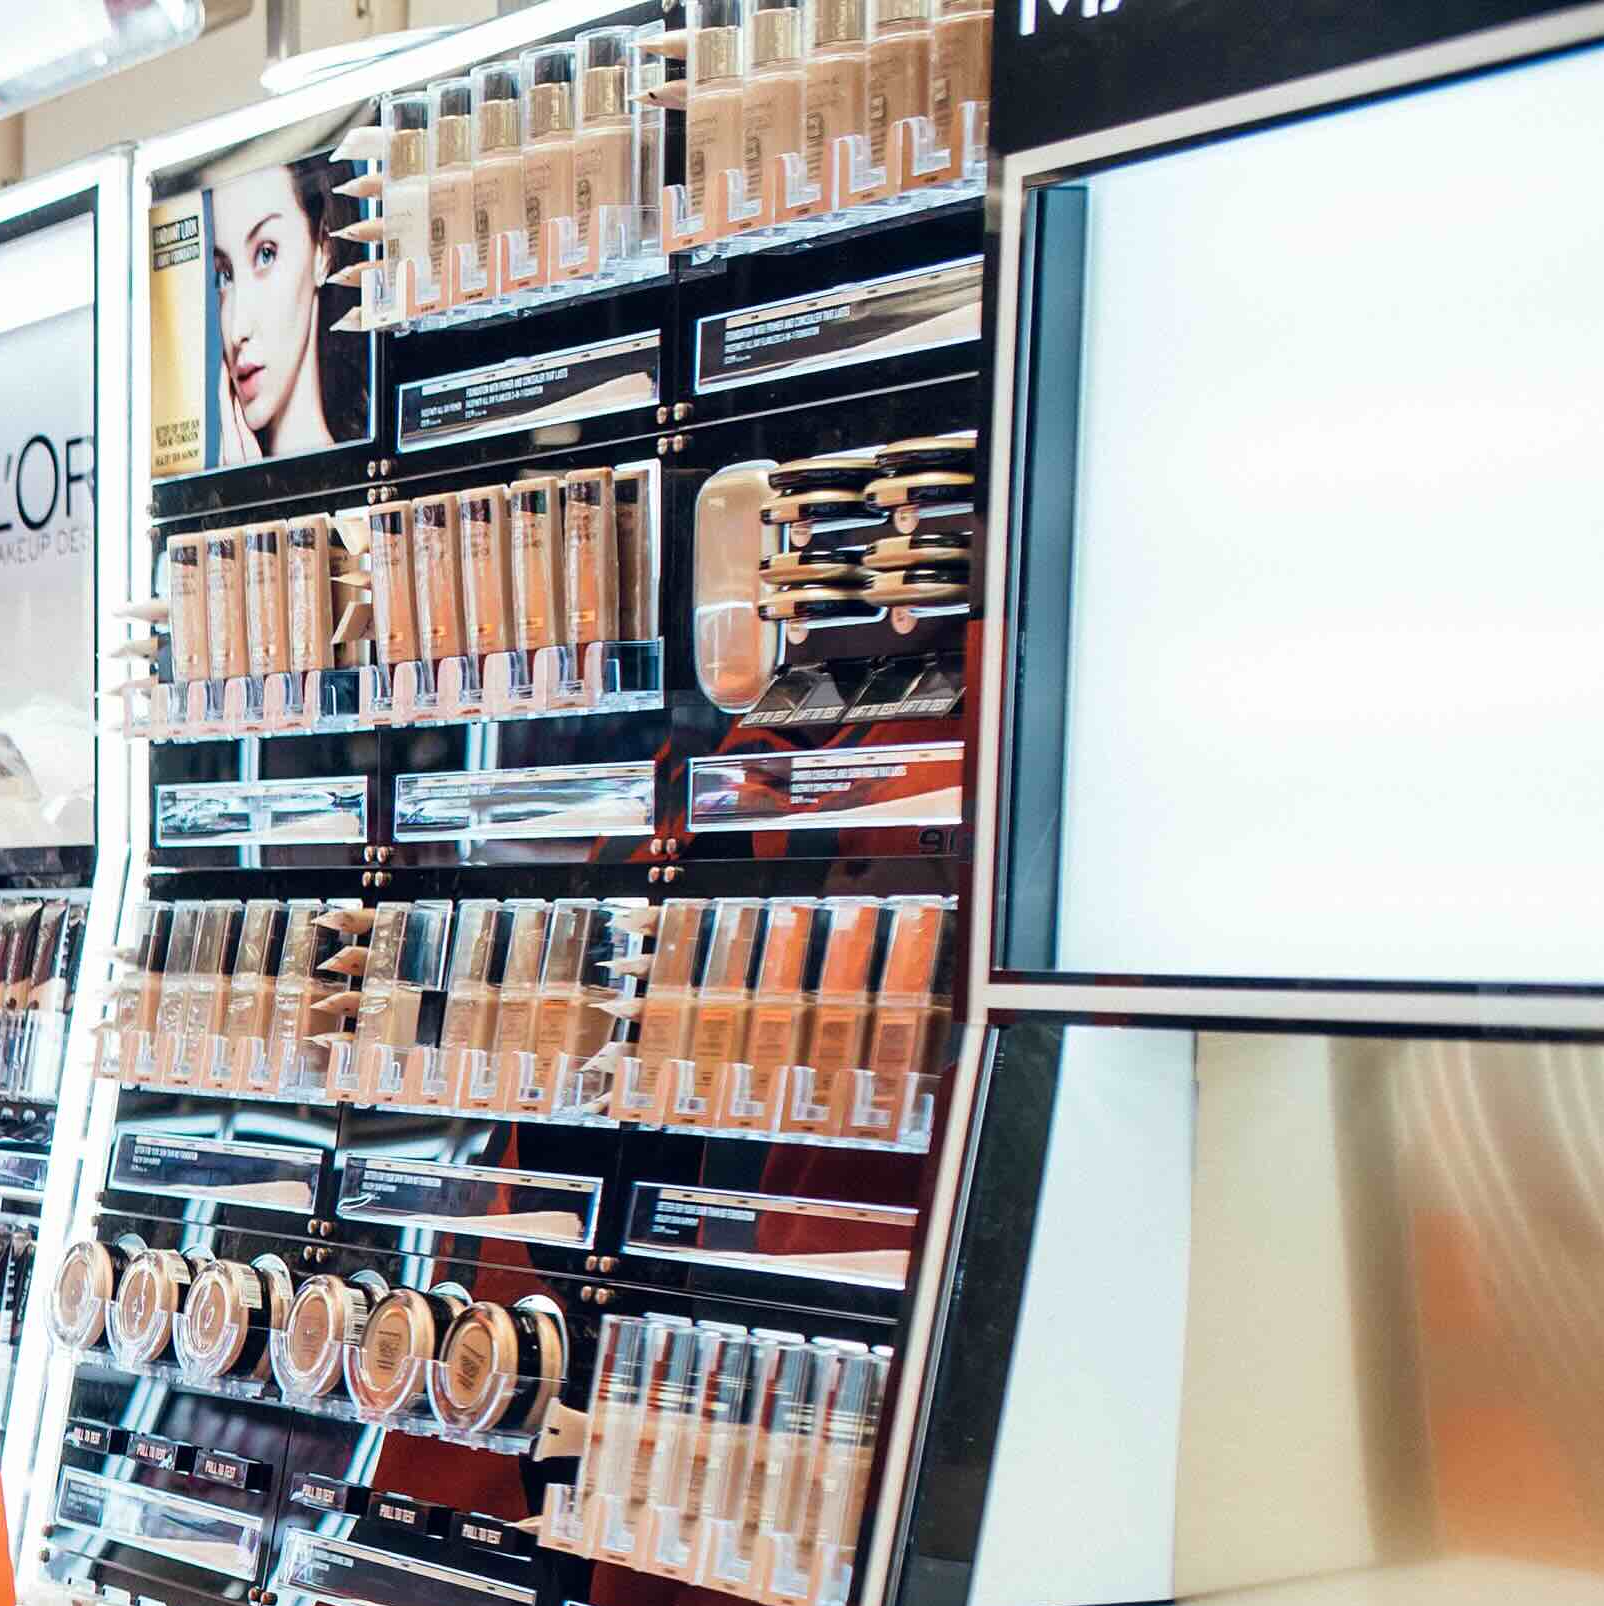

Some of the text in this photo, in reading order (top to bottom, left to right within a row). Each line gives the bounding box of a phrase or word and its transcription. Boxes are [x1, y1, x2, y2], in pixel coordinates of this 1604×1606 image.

[379, 1503, 394, 1518] PULL
[402, 1509, 416, 1524] TEST
[462, 1523, 478, 1539] PULL
[487, 1529, 503, 1544] TEST
